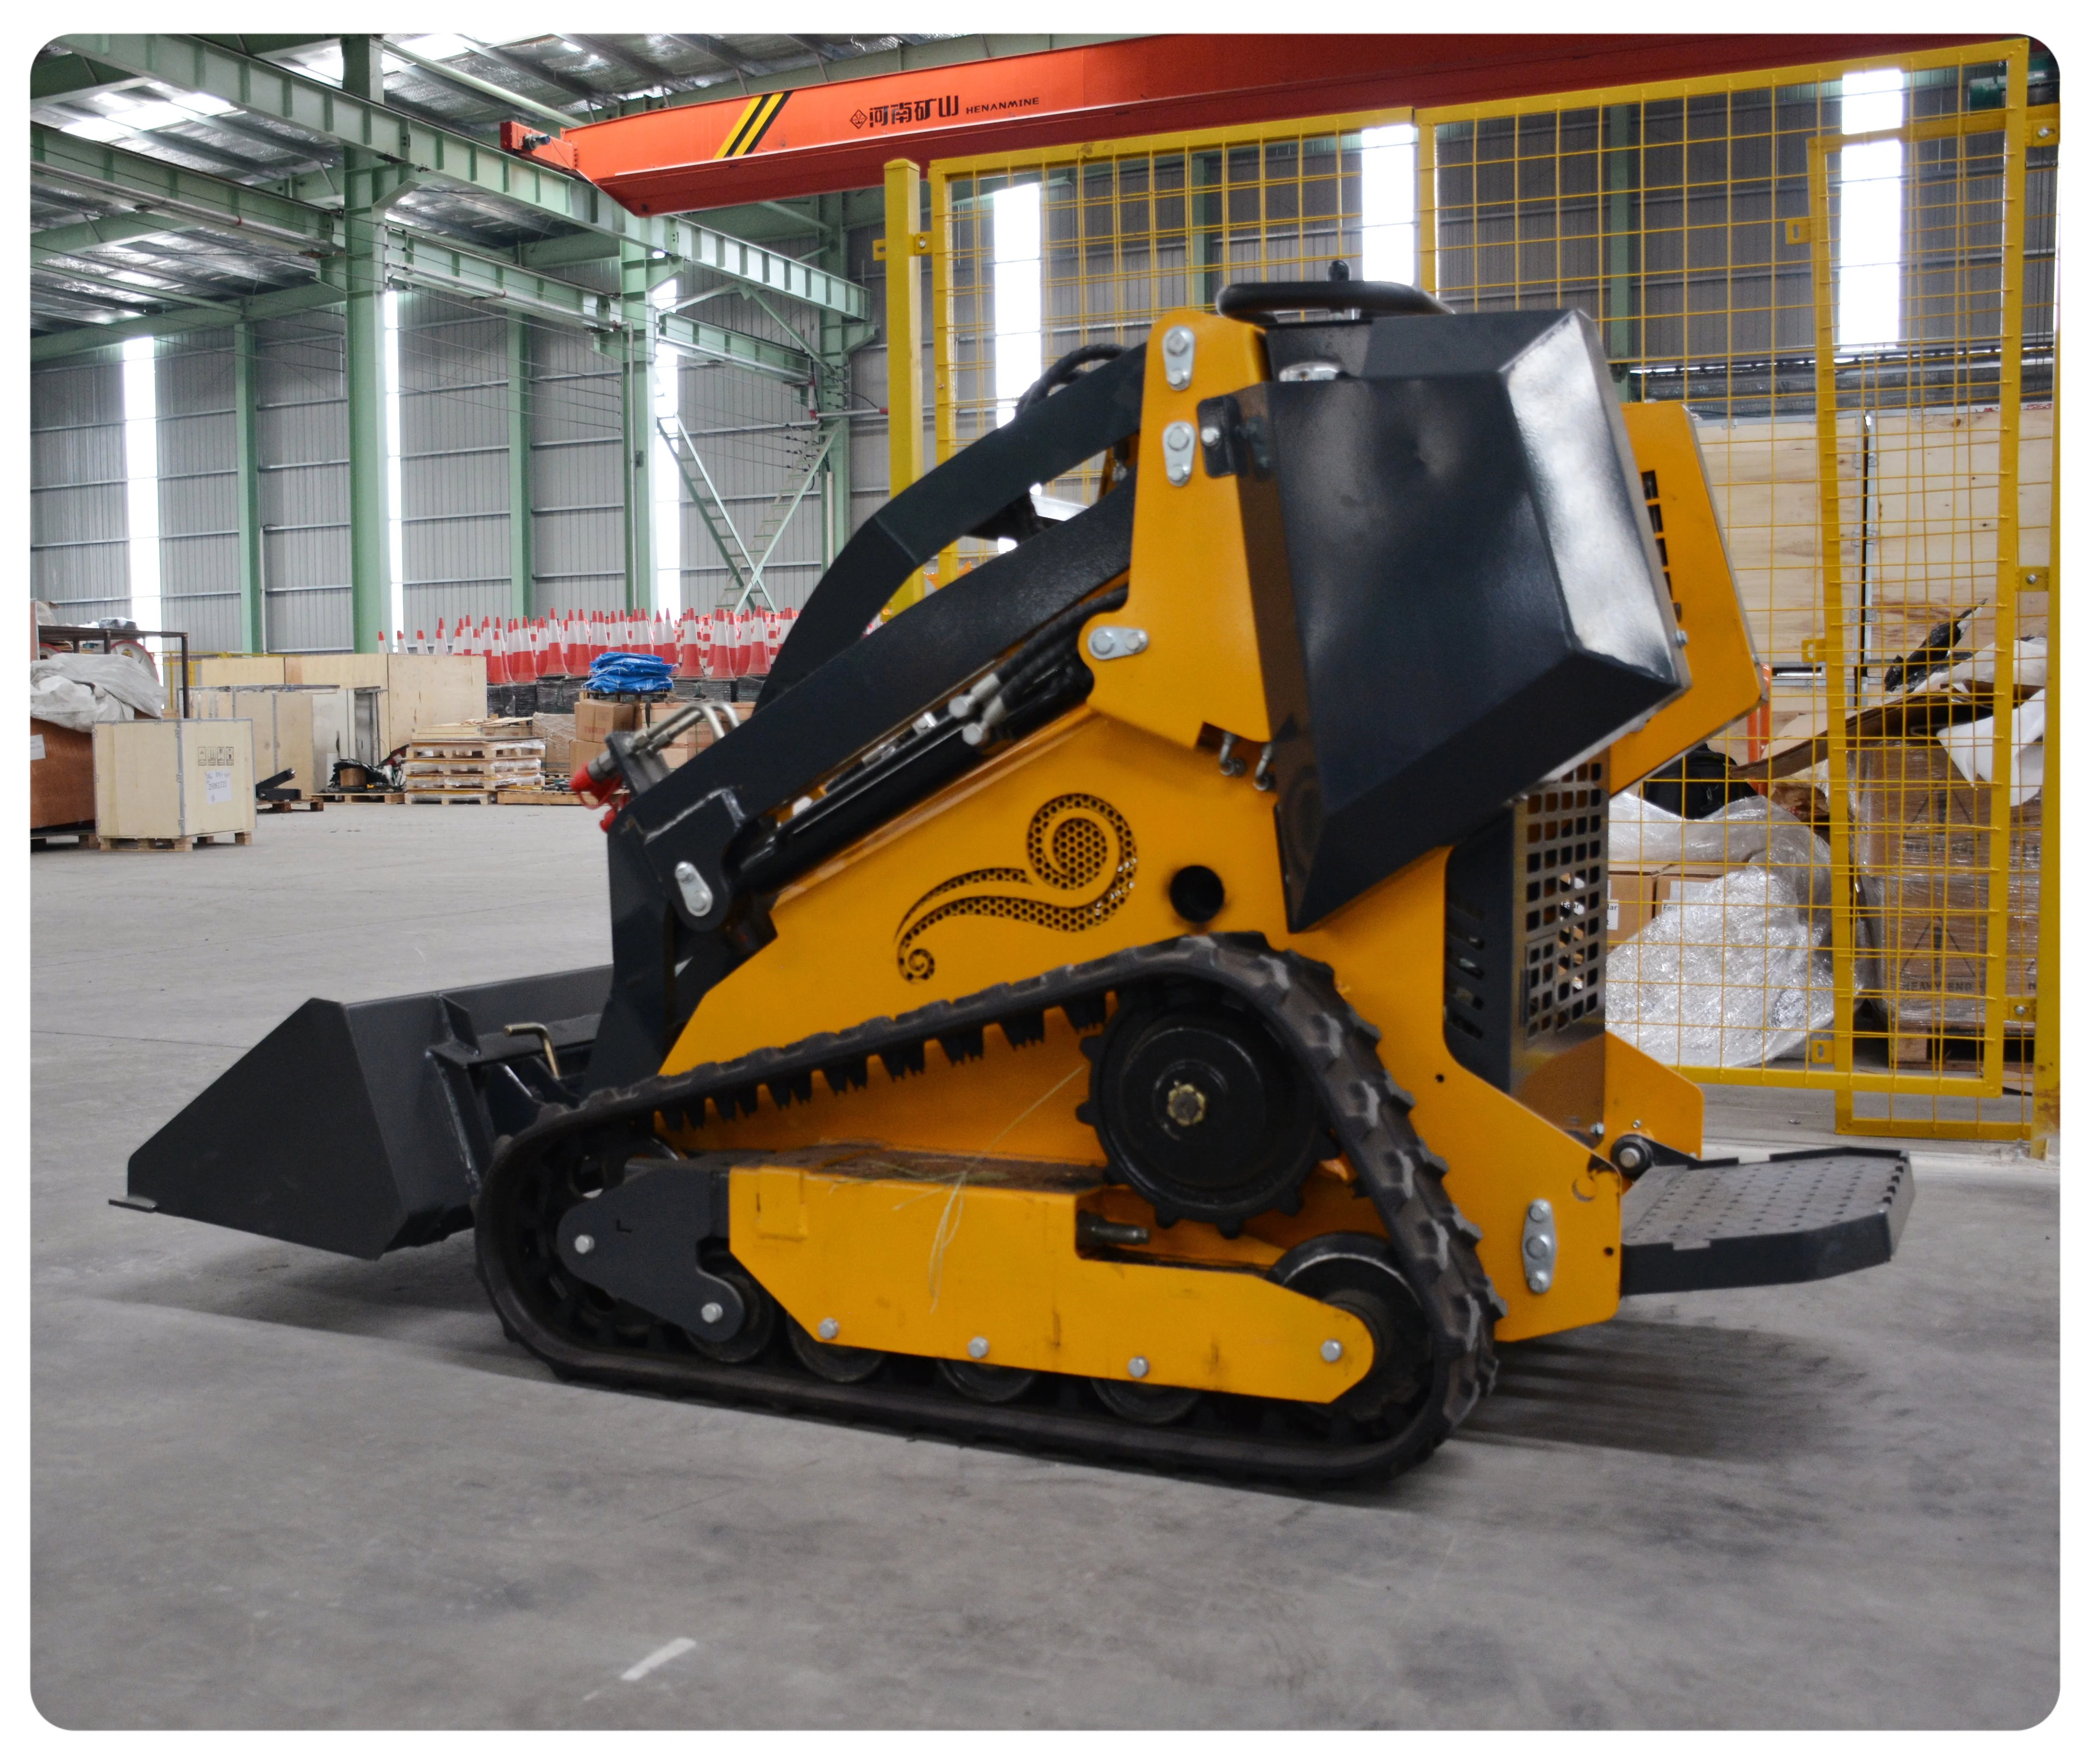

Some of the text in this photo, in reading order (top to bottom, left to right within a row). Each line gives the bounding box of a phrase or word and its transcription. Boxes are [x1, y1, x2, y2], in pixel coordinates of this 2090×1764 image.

[869, 95, 1039, 128] 河南矿山 HENANMINE
